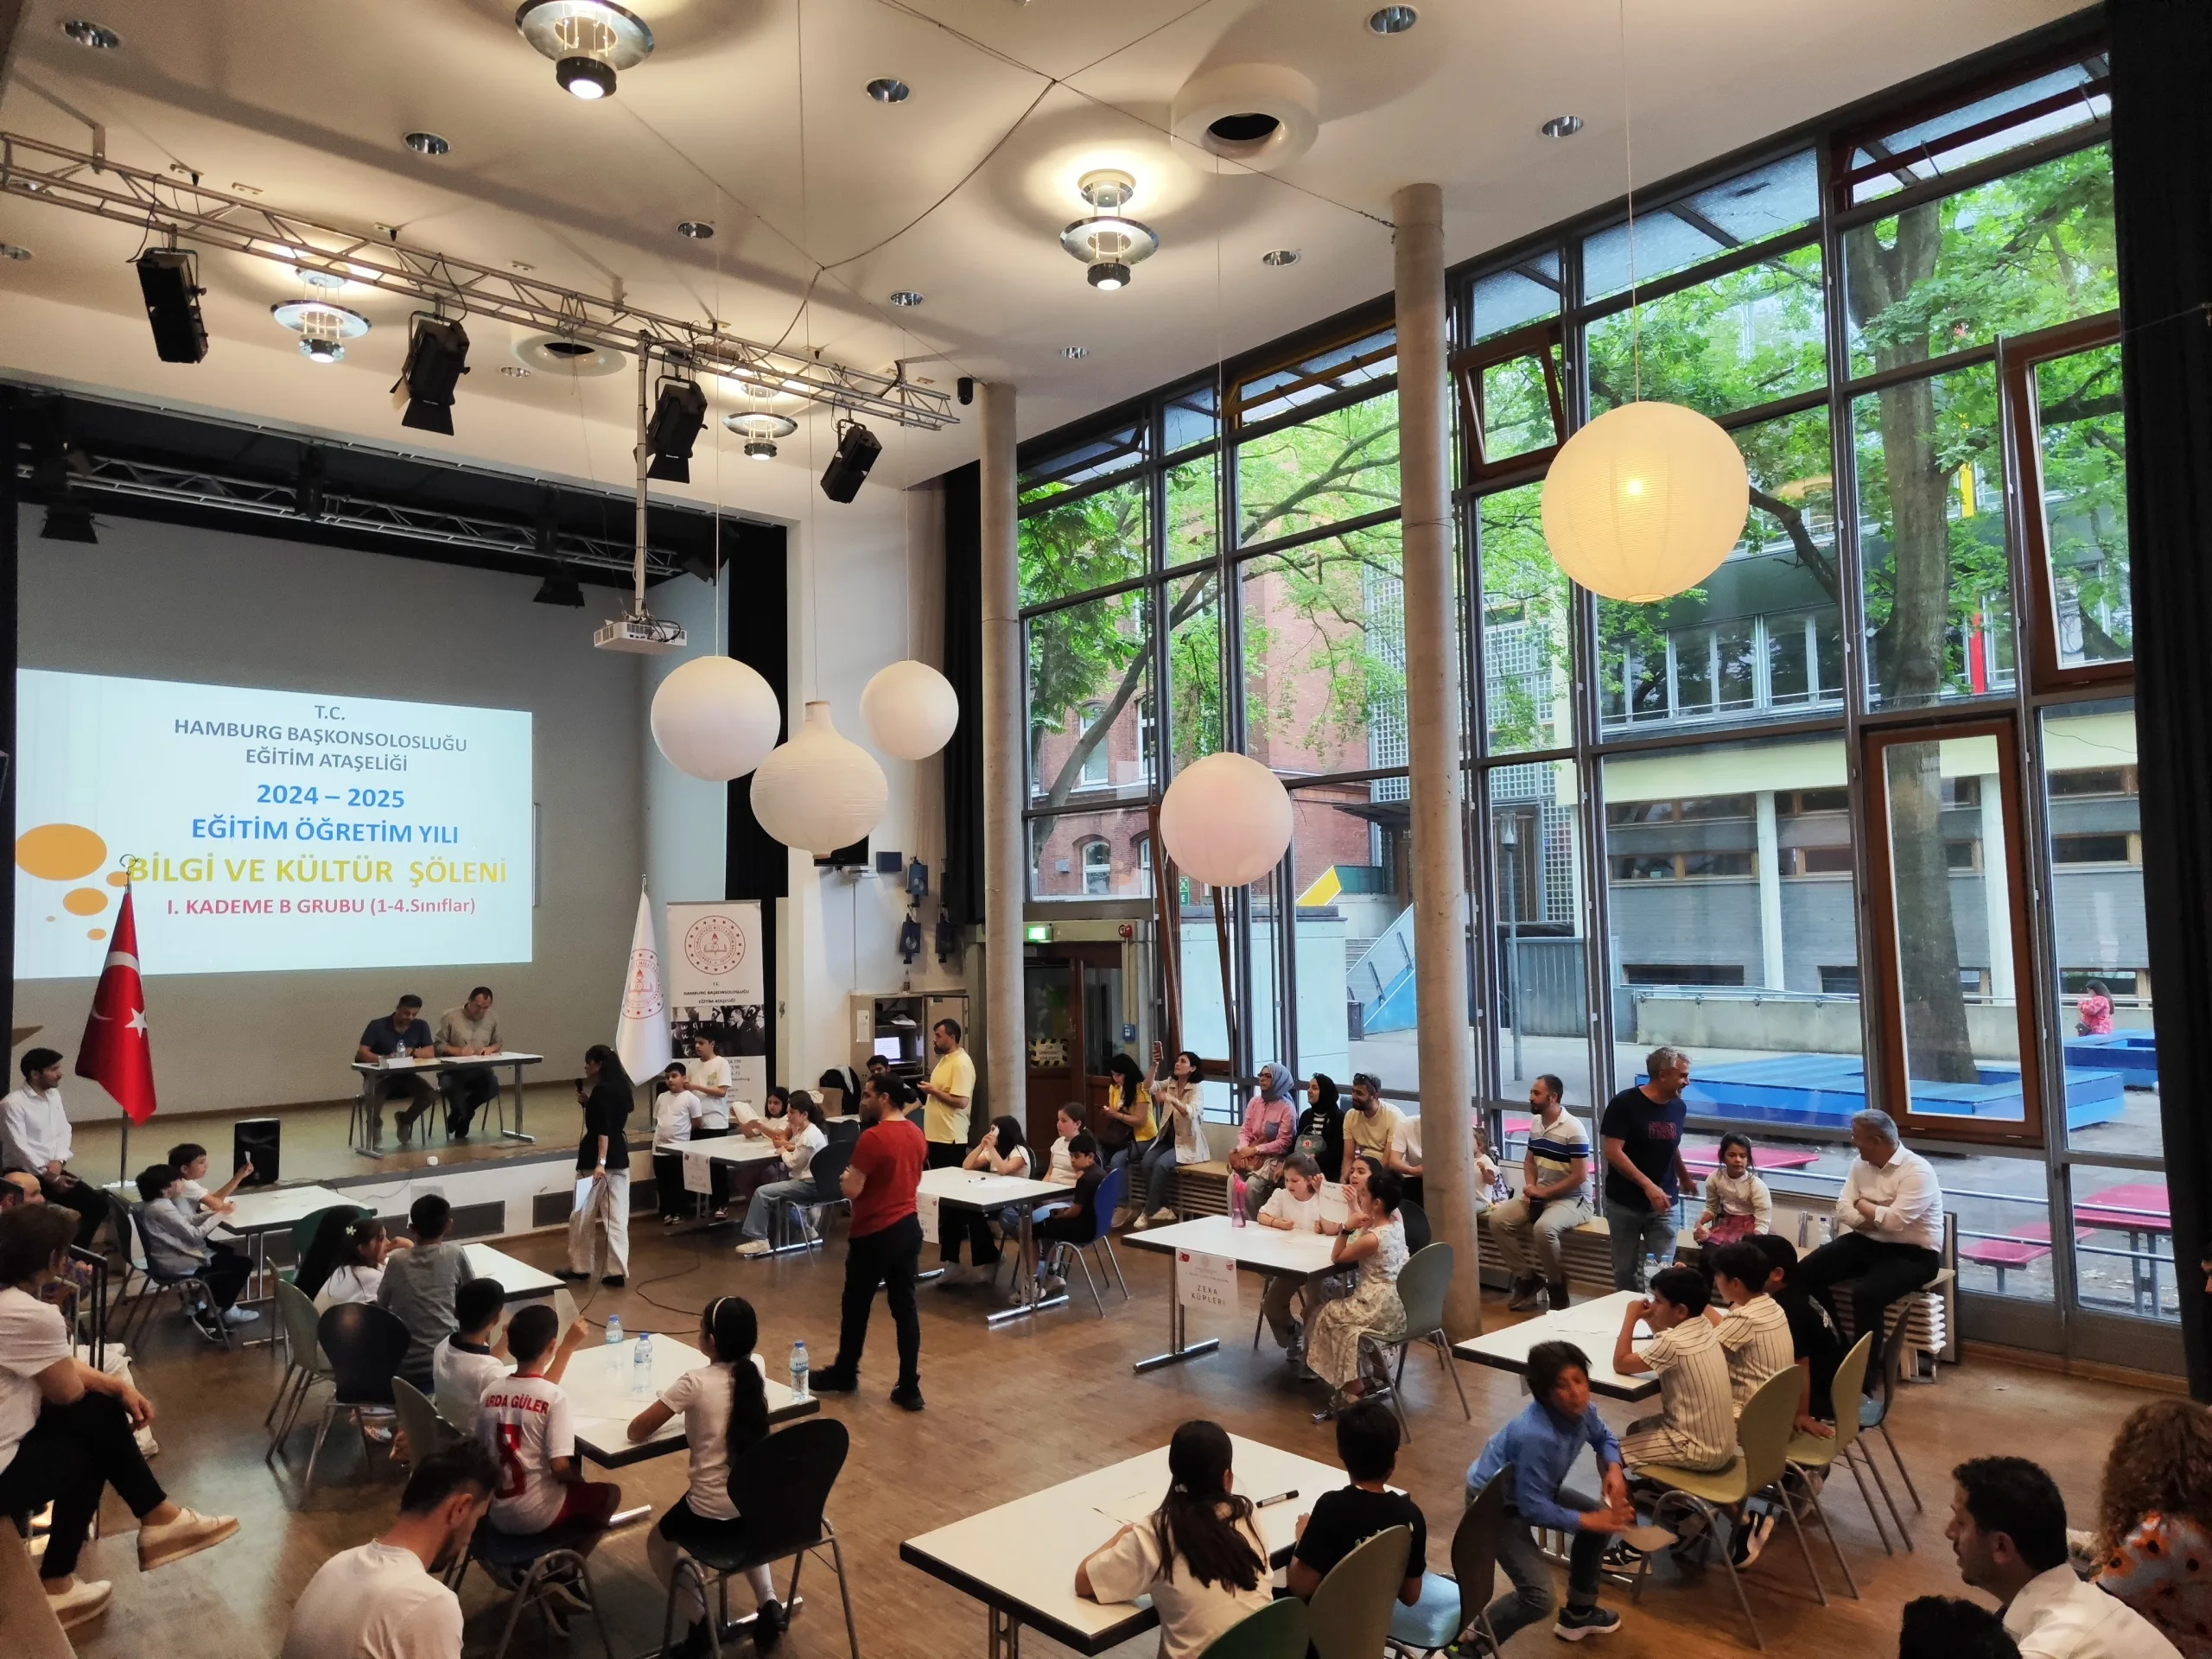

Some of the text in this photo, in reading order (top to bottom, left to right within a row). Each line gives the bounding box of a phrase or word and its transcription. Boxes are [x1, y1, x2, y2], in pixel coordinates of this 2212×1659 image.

[315, 705, 346, 721] T.C.
[175, 719, 467, 752] HAMBURG BAŞKONSOLOSLUĞU
[246, 747, 408, 772] EĞİTİM ATAŞELİĞİ
[257, 784, 319, 805] 2024
[347, 787, 405, 809] 2025
[192, 814, 459, 844] EĞİTİM ÖĞRETİM YILI
[129, 851, 507, 888] BİLGİ VE KÜLTÜR ŞÖLENİ
[168, 898, 475, 916] I. KADEME B GRUBU (1-4.Sınıflar)
[1198, 1284, 1217, 1295] ZEKA
[485, 1393, 550, 1415] ARDA GÜLER
[496, 1422, 526, 1500] 8
